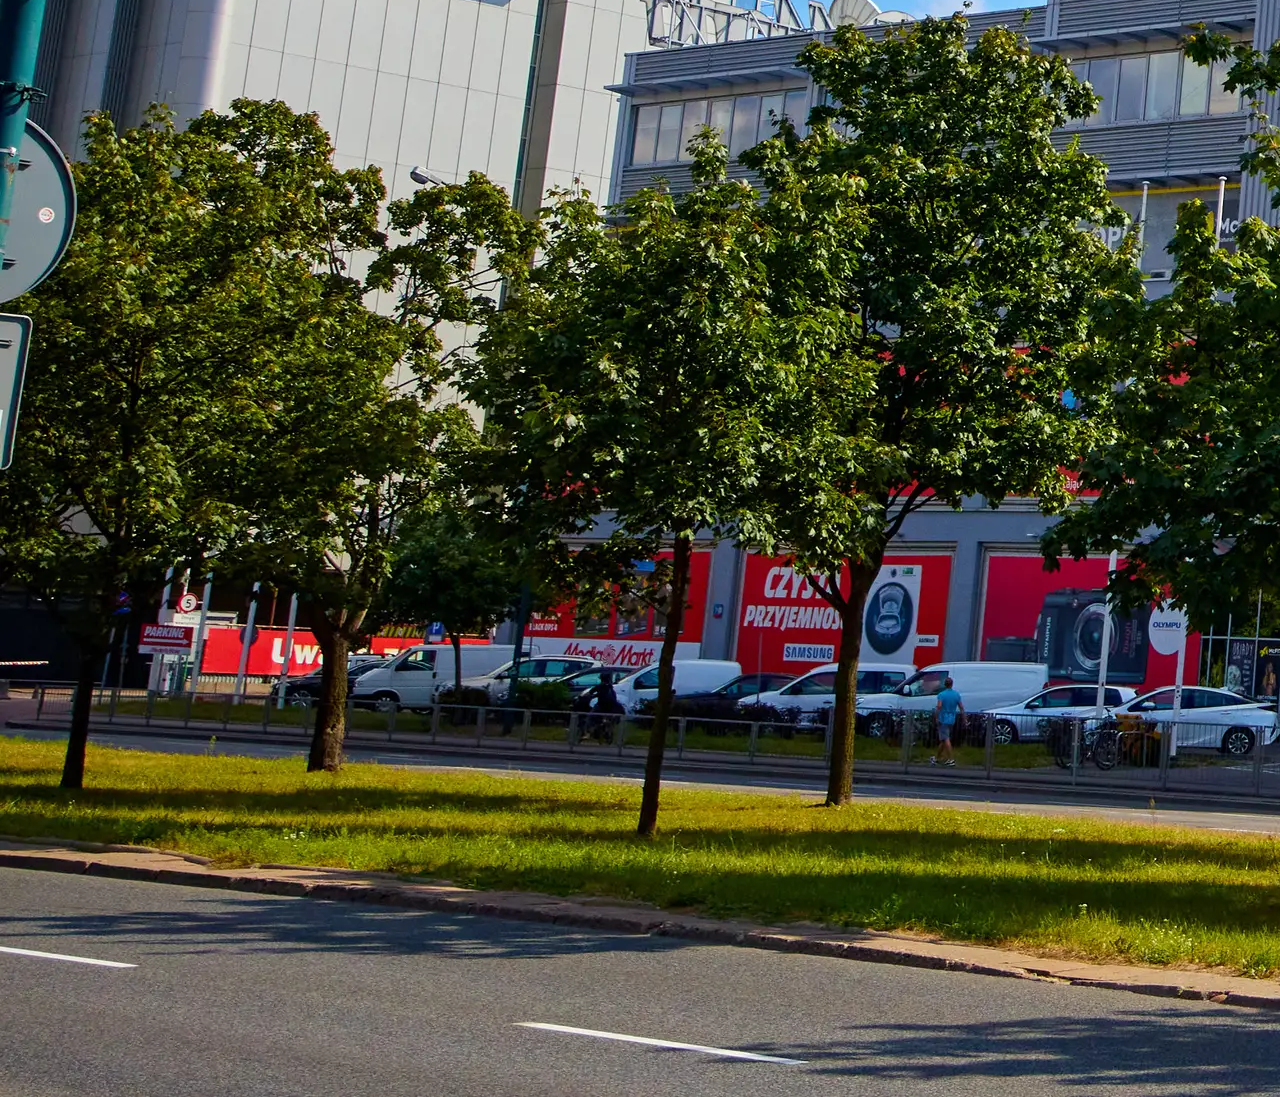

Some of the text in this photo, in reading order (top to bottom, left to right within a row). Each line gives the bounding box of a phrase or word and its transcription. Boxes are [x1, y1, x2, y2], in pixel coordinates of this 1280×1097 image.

[185, 599, 192, 609] 5
[144, 625, 186, 639] PARKING
[1152, 621, 1182, 629] OLYMPU
[1043, 616, 1052, 658] OLYMPUS
[784, 646, 834, 660] SAMSUNG
